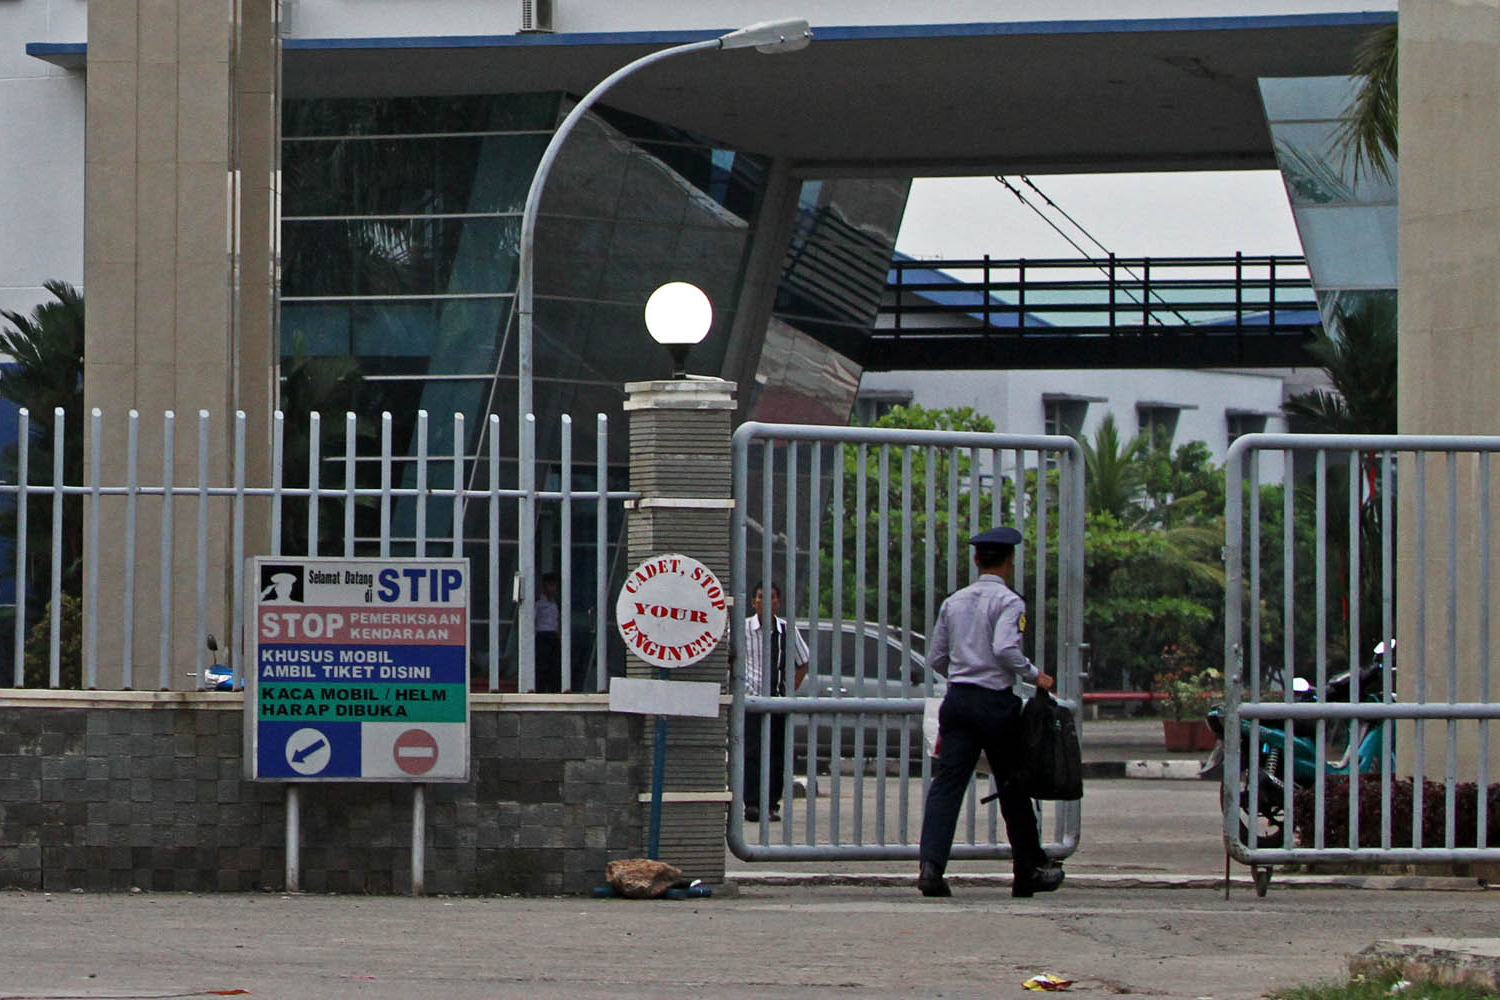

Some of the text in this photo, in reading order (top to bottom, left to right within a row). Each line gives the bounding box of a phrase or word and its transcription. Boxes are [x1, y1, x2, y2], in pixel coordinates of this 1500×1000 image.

[308, 569, 373, 586] Selamat Datang
[626, 559, 726, 611] CADET, STOP
[377, 568, 463, 603] STIP
[364, 589, 373, 603] di
[349, 612, 461, 625] PEMERIKSAAN
[634, 602, 709, 624] YOUR
[261, 612, 344, 639] STOP
[350, 628, 449, 640] KENDARAAN
[621, 618, 717, 660] ENGINE!!!
[261, 649, 393, 664] KHUSUS MOBIL
[262, 664, 431, 679] AMBIL TIKET DISINI
[261, 687, 314, 700] KACA
[320, 688, 380, 701] MOBIL
[394, 688, 447, 702] HELM
[261, 703, 408, 717] HARAP DIBUKA
